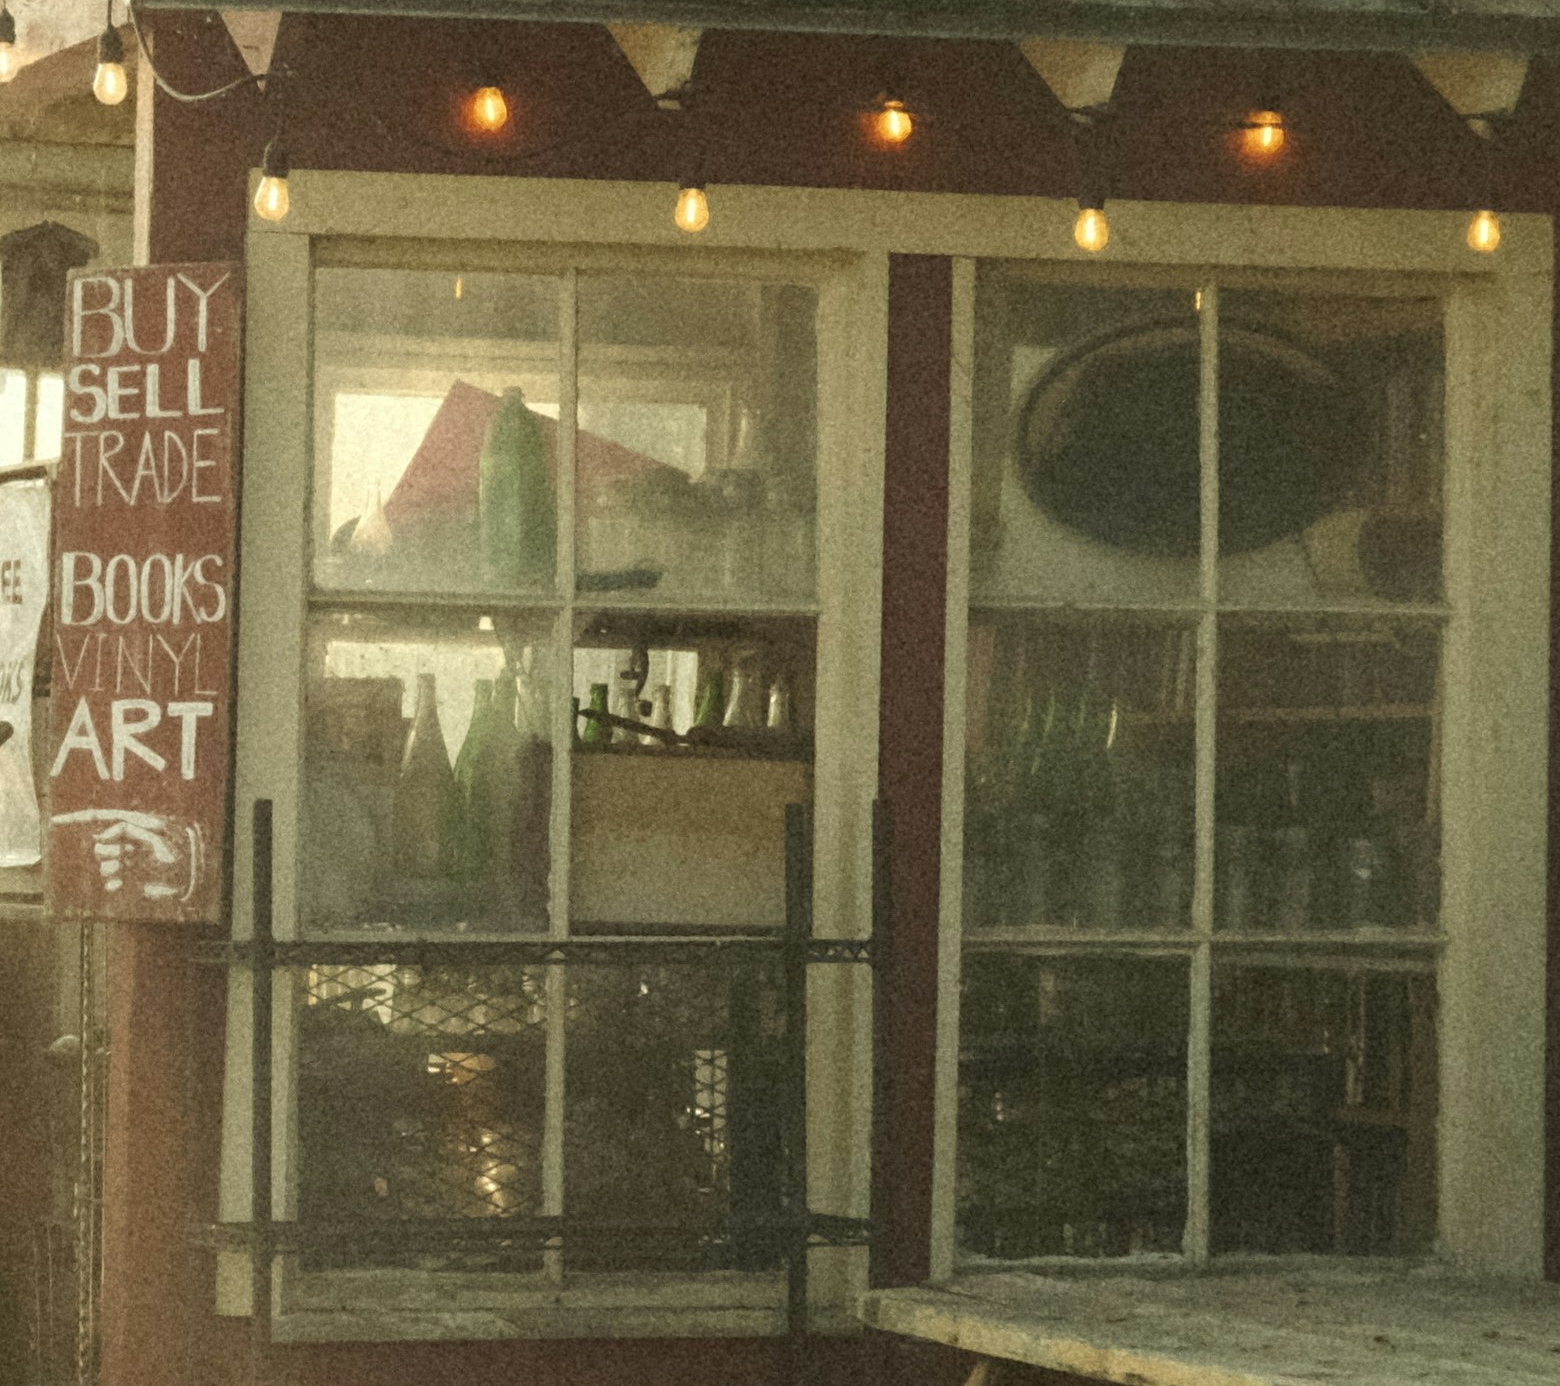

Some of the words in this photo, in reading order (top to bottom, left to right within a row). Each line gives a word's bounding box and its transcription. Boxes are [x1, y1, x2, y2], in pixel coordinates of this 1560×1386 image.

[72, 273, 230, 358] BUY
[68, 358, 225, 423] SELL
[64, 428, 222, 507] TRADE
[61, 552, 226, 626] BOOKS
[55, 632, 219, 695] VINYL
[49, 696, 214, 781] ART
